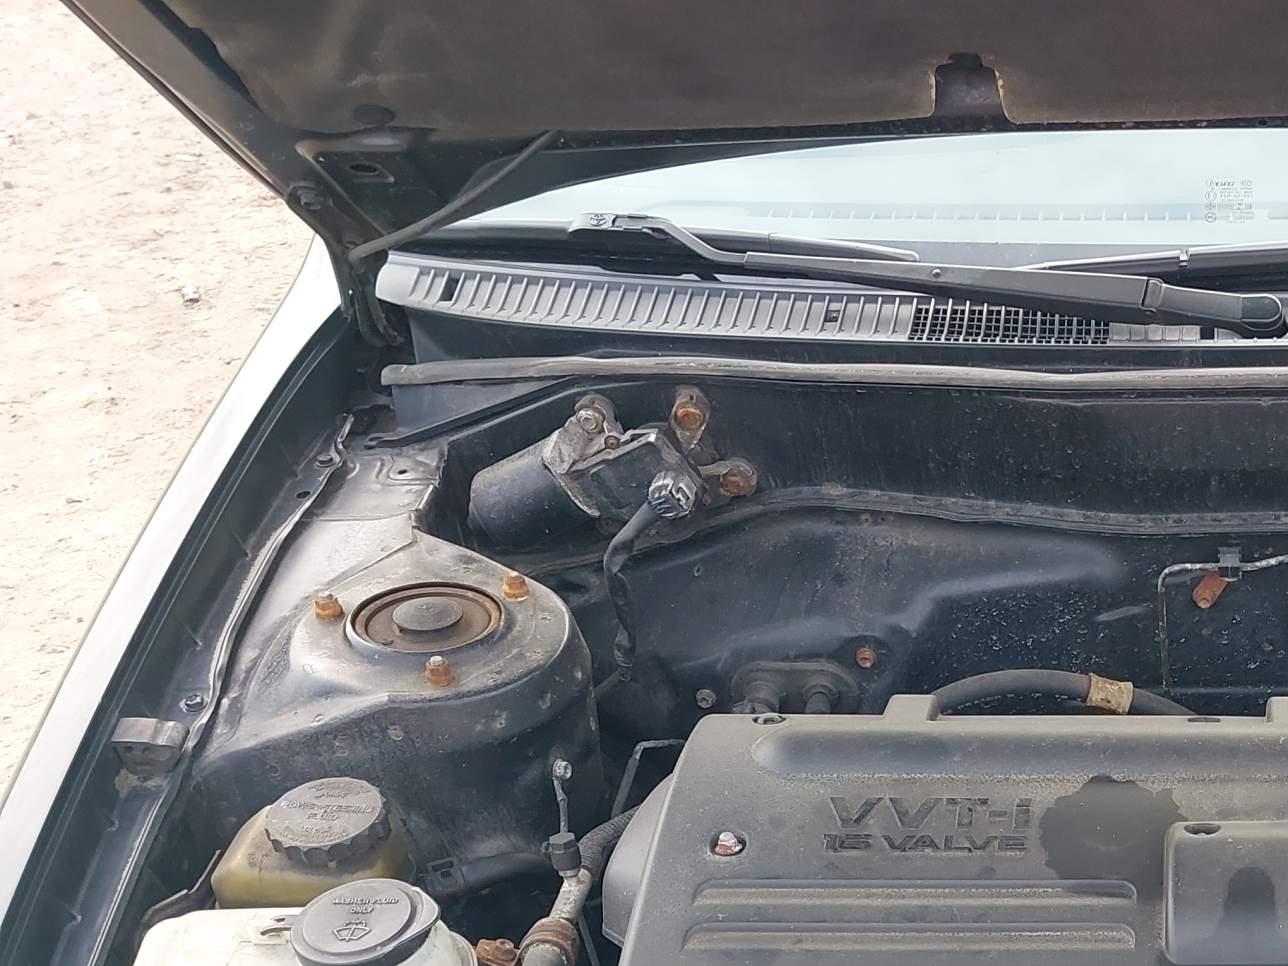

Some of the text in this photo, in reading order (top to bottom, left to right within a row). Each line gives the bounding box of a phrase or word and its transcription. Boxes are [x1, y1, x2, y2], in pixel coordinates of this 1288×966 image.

[823, 833, 1028, 852] 16 VALVE
[332, 896, 400, 905] WASHER FLUID
[349, 906, 376, 914] ONLY
